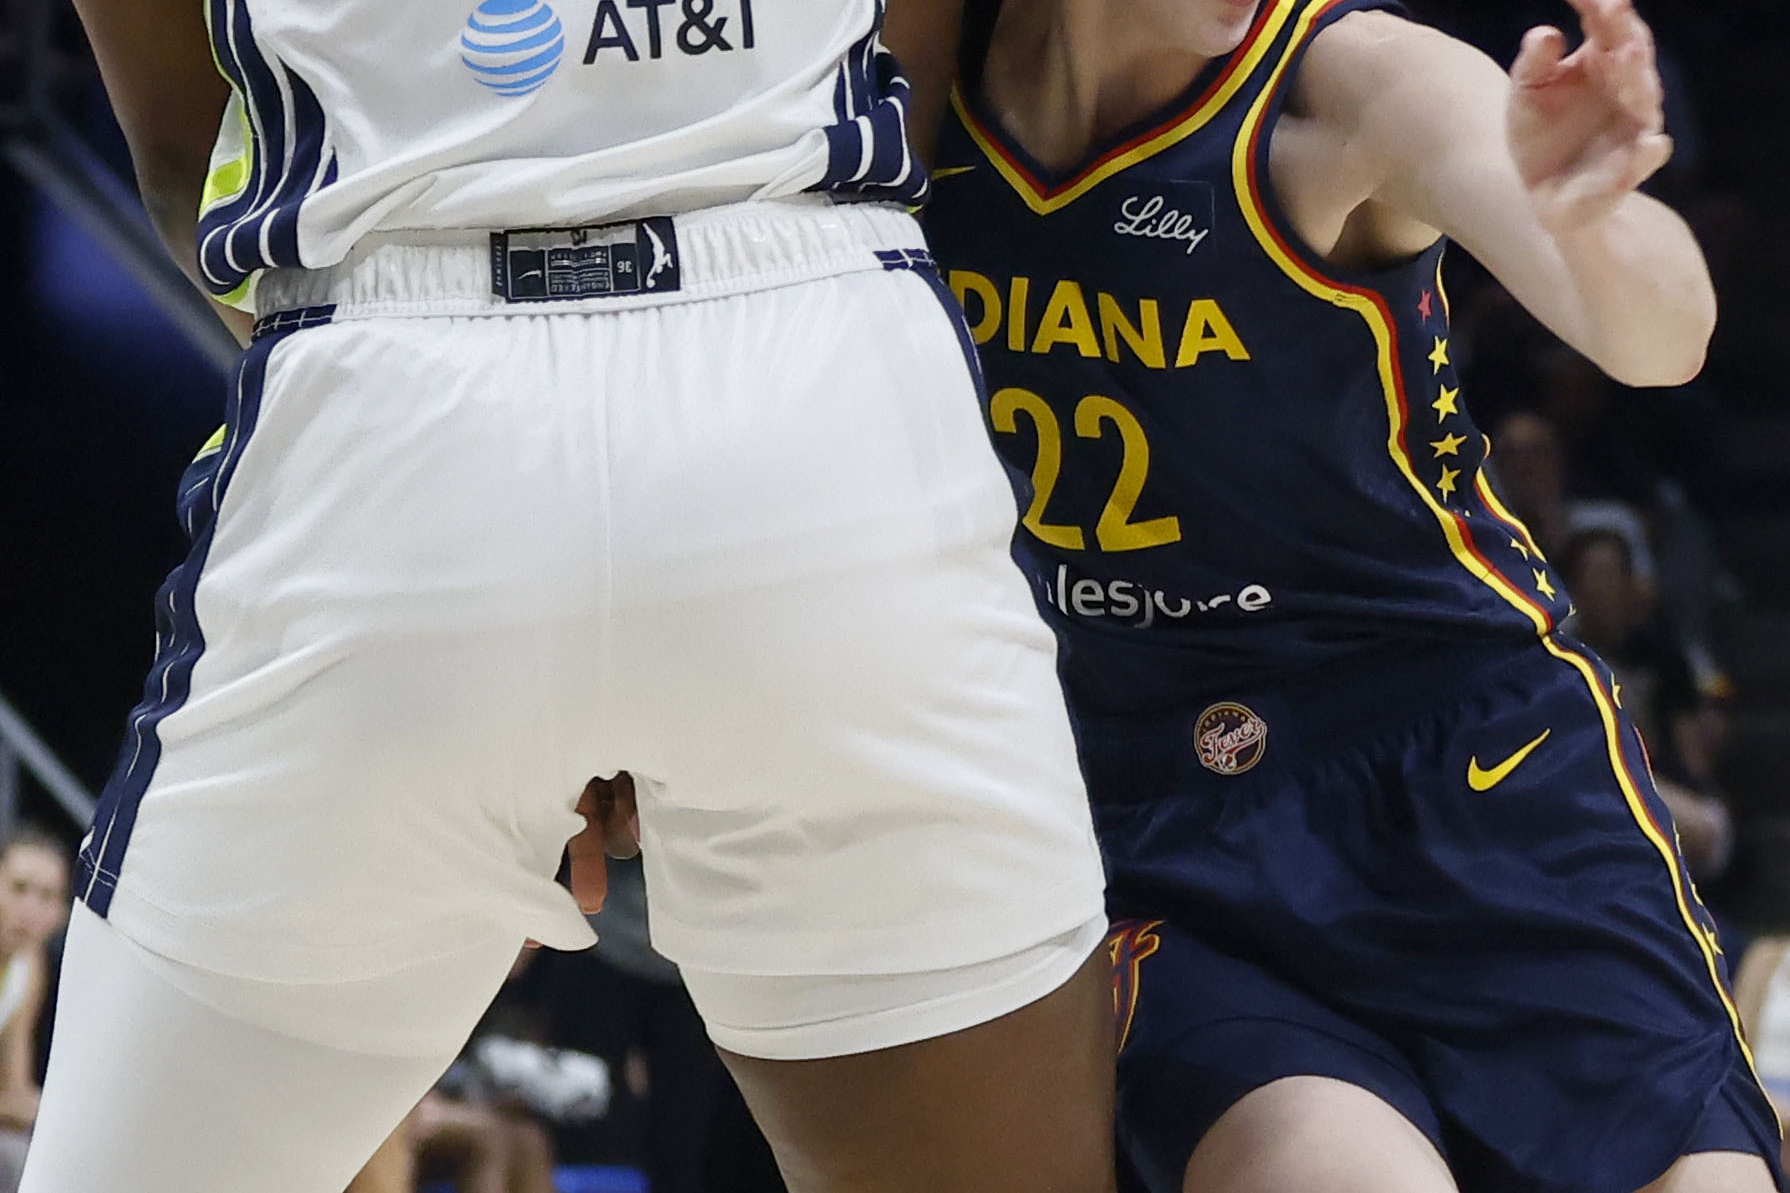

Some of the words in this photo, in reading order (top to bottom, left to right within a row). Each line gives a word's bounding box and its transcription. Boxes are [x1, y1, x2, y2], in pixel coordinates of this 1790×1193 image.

[1114, 196, 1209, 254] Lilly
[616, 260, 633, 274] 36
[949, 270, 1251, 369] DIANA
[991, 387, 1181, 552] 22
